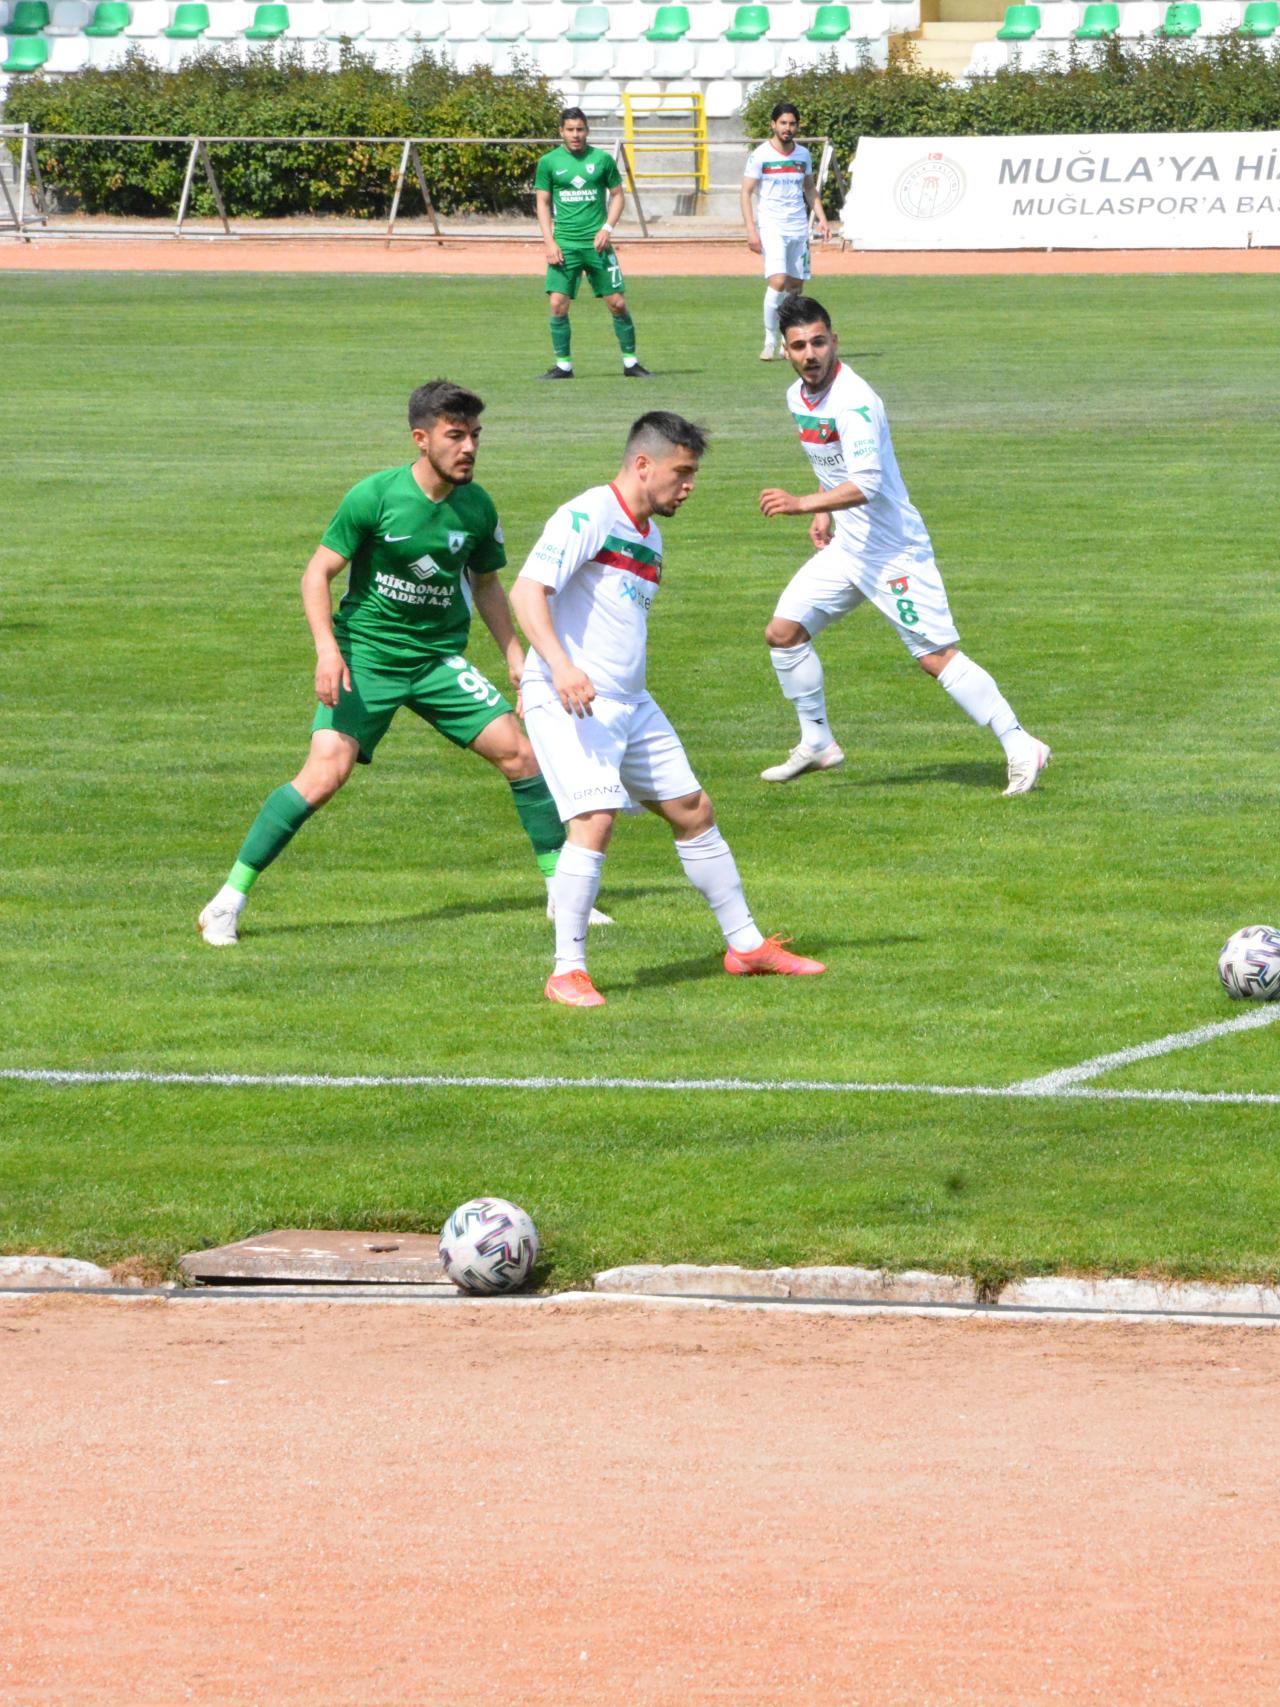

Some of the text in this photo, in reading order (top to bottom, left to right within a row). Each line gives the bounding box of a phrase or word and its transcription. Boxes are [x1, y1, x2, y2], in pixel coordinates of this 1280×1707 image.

[998, 150, 1220, 184] MUĞLA'YA
[1012, 193, 1227, 217] MUĞLASPOR'A
[377, 584, 427, 605] MADEN
[896, 598, 919, 626] 8
